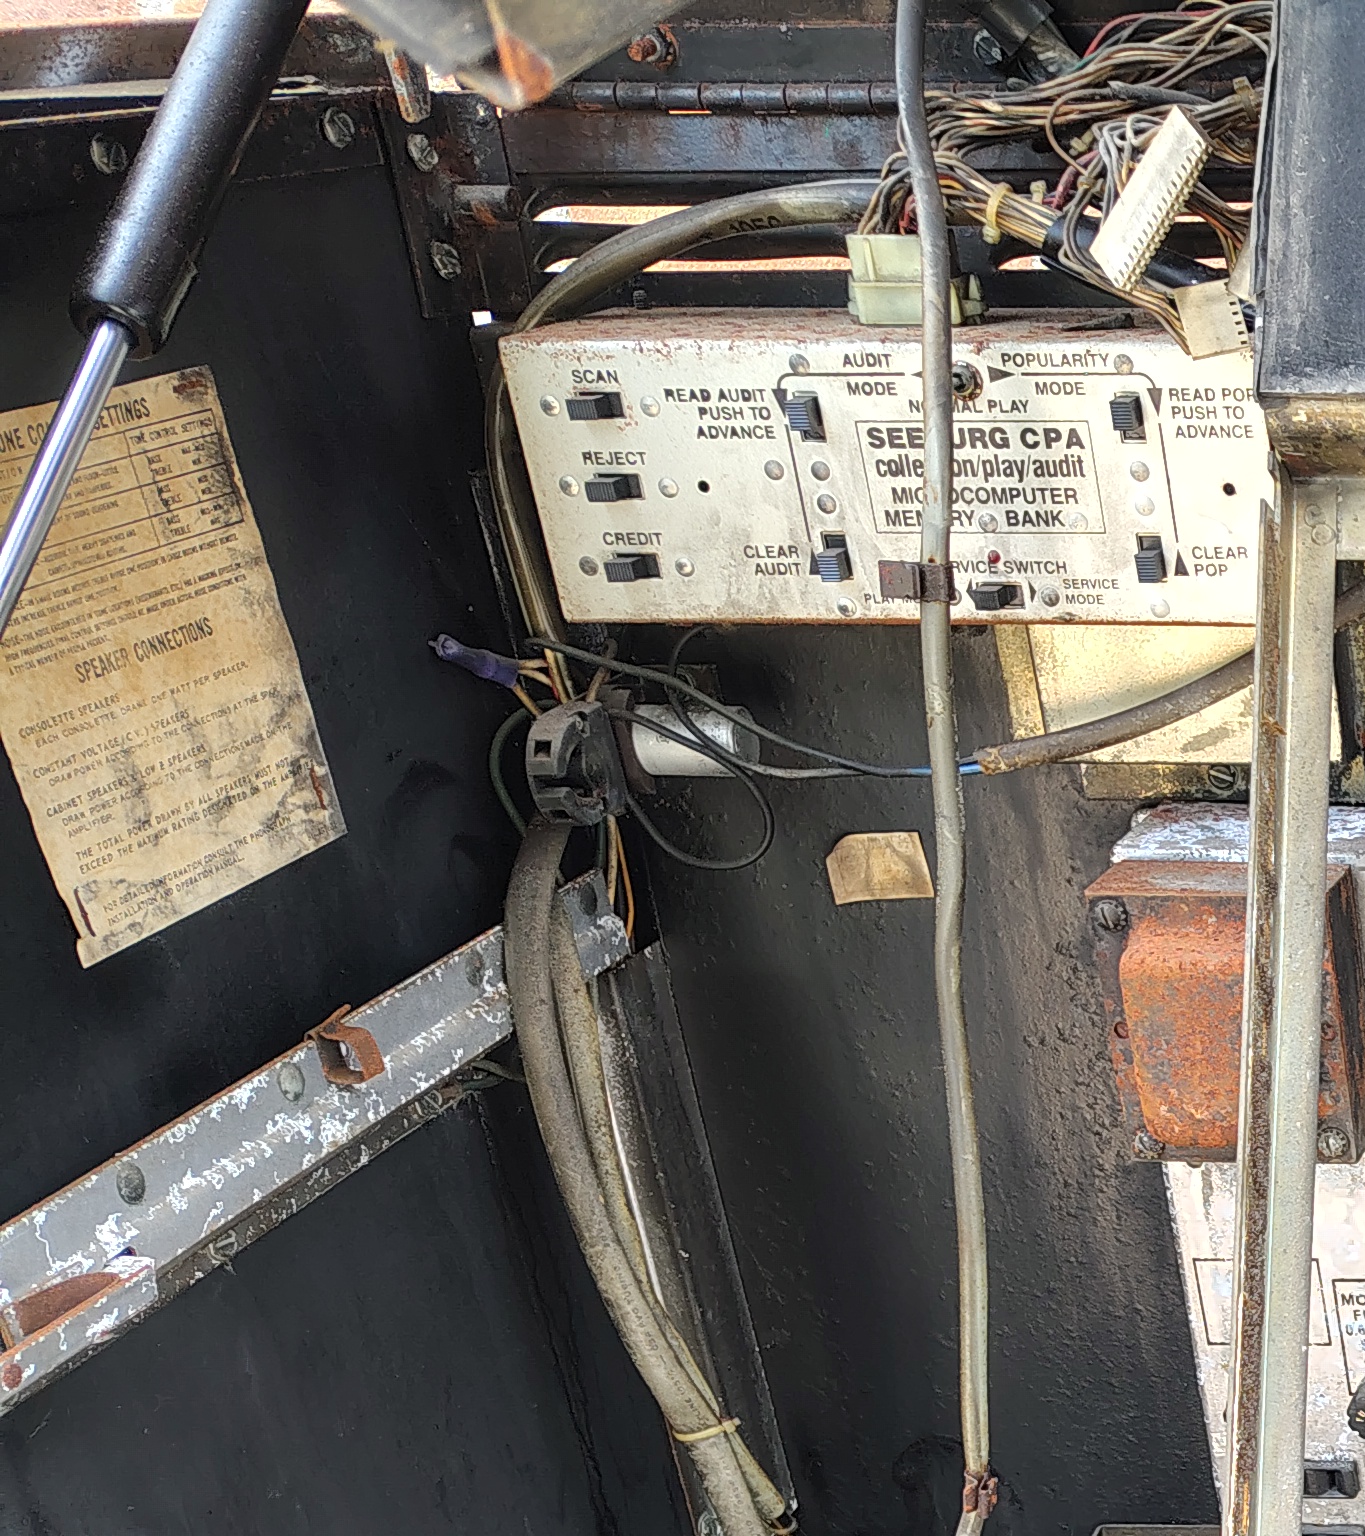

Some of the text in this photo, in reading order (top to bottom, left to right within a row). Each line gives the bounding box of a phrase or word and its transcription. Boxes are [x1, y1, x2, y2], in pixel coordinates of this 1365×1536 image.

[842, 353, 892, 368] AUDIT
[1000, 352, 1109, 369] POPULARITY
[571, 368, 620, 385] SCAN
[663, 387, 767, 403] READ AUDIT
[846, 381, 898, 396] MODE
[1034, 381, 1086, 396] MODE
[1168, 387, 1254, 403] READ POP
[698, 406, 772, 421] PUSH TO
[908, 399, 1029, 414] NMAL PLAY
[1171, 405, 1245, 420] PUSH TO
[696, 425, 776, 440] ADVANCE
[866, 427, 1086, 450] SEEURG CPA
[1175, 424, 1255, 439] ADVANCE
[581, 450, 647, 466] REJECT
[875, 453, 1085, 483] colleon/play/audit
[891, 486, 1079, 505] MICOCOMPUTER
[1005, 510, 1065, 528] BANK
[602, 531, 663, 547] CREDIT
[742, 544, 801, 560] CLEAR
[1191, 546, 1248, 560] CLEAR
[754, 562, 802, 577] AUDIT
[1003, 560, 1068, 575] SWITCH
[1193, 563, 1229, 577] POP
[1063, 578, 1119, 590] SERVICE
[1065, 593, 1105, 606] MODE
[74, 615, 214, 684] SPEAKER CONNECTIONS
[18, 692, 121, 739] CONSOLETTE SPEAKERS
[45, 794, 84, 818] CABINET
[86, 776, 130, 801] SPEAKERS
[75, 847, 93, 861] THE
[97, 834, 125, 853] TOTAL
[215, 774, 252, 799] SPEAKERS
[79, 853, 114, 875] EXCEED
[117, 842, 134, 856] THE
[171, 813, 200, 832] RATING
